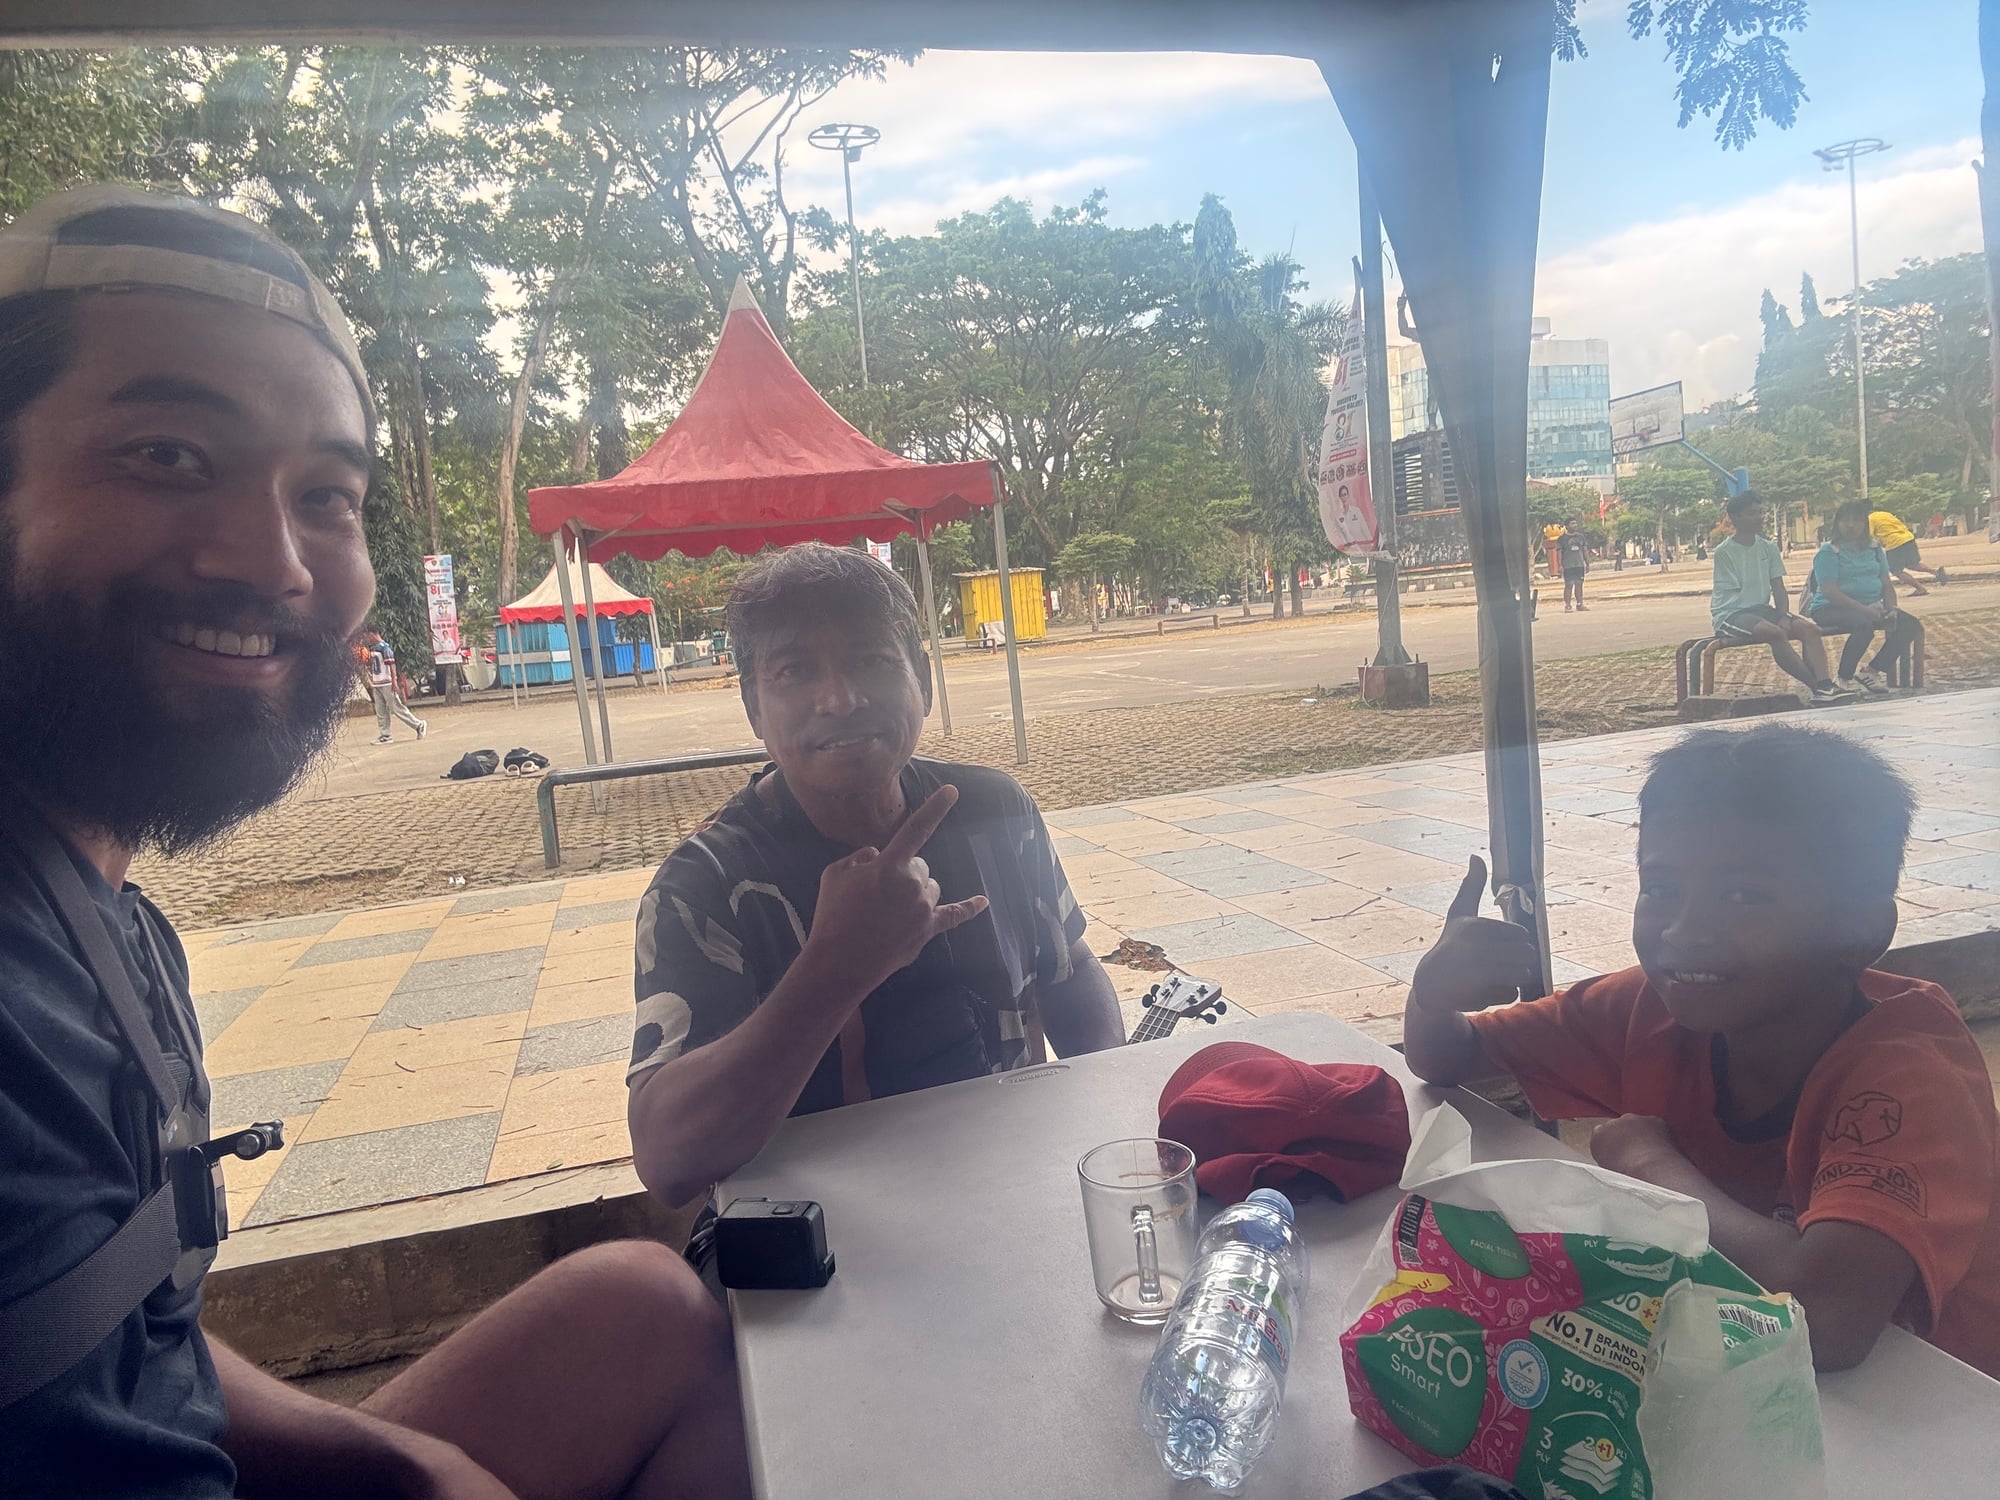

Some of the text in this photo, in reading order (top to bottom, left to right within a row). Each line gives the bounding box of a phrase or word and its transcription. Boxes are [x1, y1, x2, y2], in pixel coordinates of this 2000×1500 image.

[1583, 1239, 1599, 1249] PLY
[1545, 1313, 1594, 1348] No.1
[1592, 1343, 1606, 1357] DI
[1596, 1332, 1638, 1359] BRAND
[1390, 1353, 1441, 1399] Smart
[1561, 1367, 1603, 1399] 30%
[1540, 1426, 1554, 1450] 3
[1535, 1449, 1551, 1464] PLY
